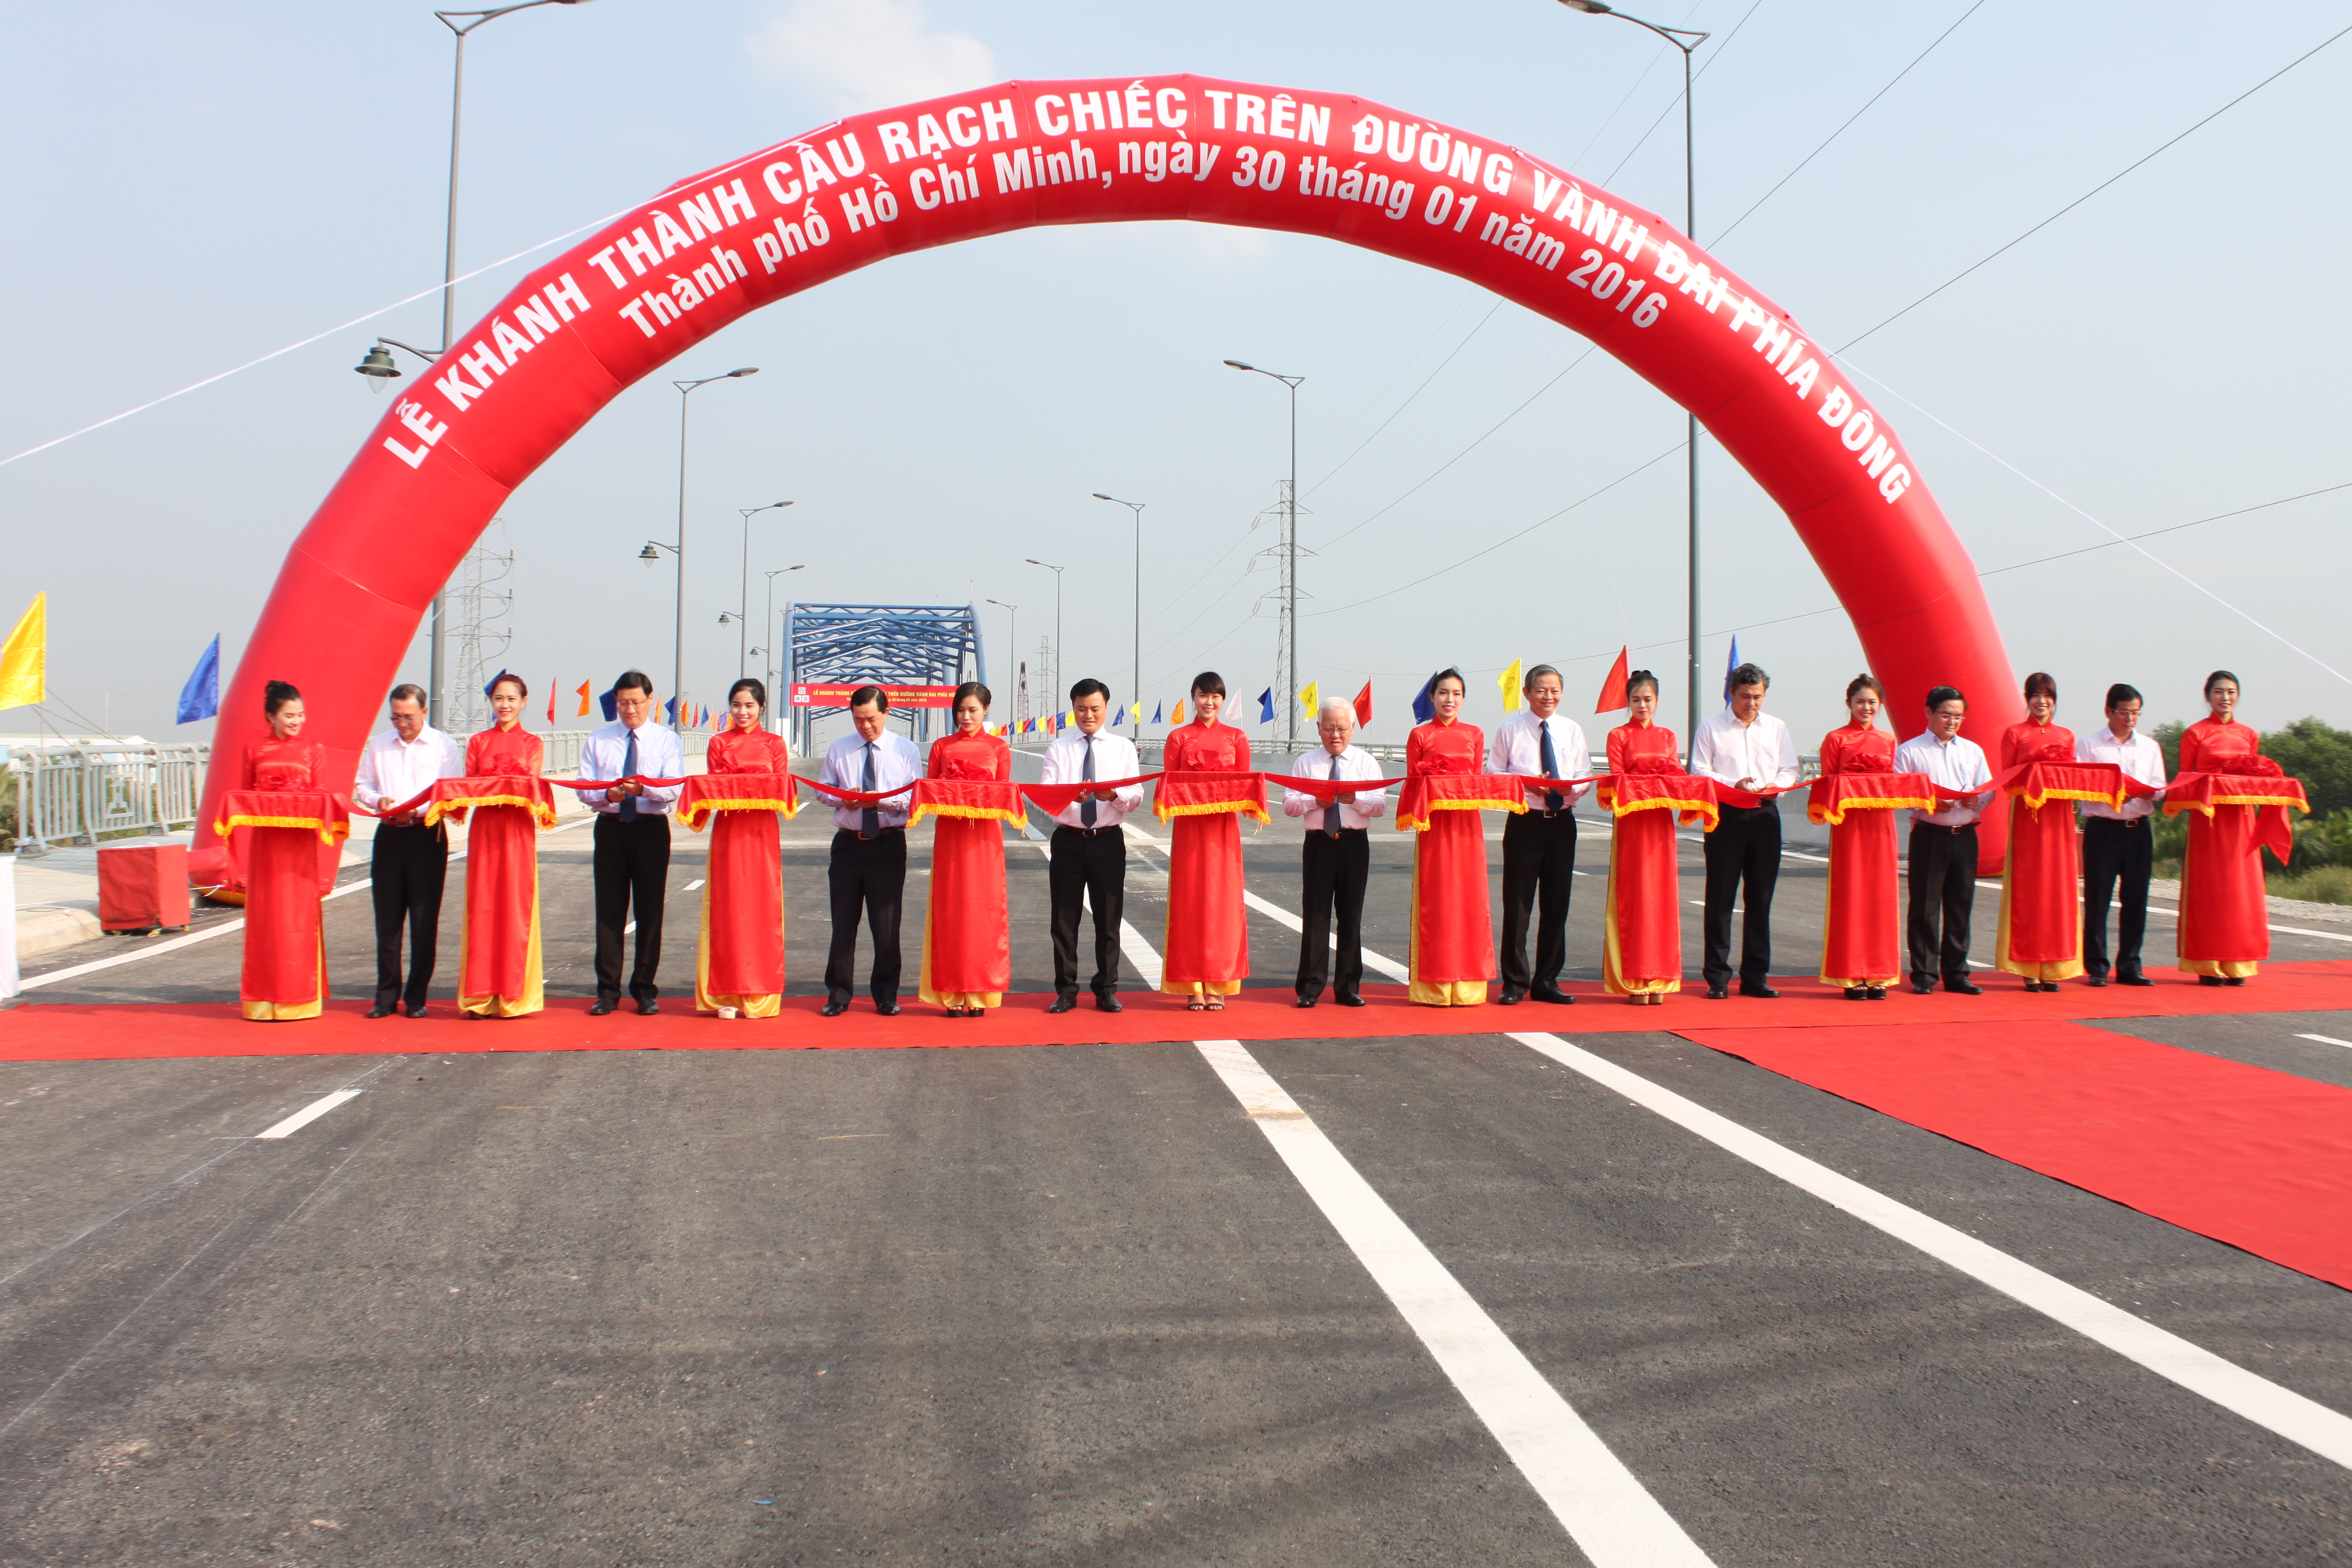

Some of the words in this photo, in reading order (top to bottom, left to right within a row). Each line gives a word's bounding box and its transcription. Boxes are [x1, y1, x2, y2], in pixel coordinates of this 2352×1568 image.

[383, 397, 448, 469] LỄ
[434, 273, 591, 412] KHÁNH
[588, 178, 757, 289] THÀNH
[763, 133, 865, 204] CẦU
[877, 98, 1018, 163] RẠCH
[1035, 80, 1187, 136] CHIẾC
[1205, 90, 1331, 147] TRÊN
[1352, 114, 1516, 196] ĐƯỜNG
[1533, 169, 1649, 262] VÀNH
[1654, 241, 1730, 314] ĐAI
[1729, 296, 1820, 399] PHÍA
[1817, 386, 1911, 504] ĐÔNG
[618, 245, 748, 338] Thành
[752, 197, 830, 274] phố
[839, 173, 898, 233] Hồ
[909, 153, 980, 210] Chí
[992, 139, 1112, 194] Minh,
[1119, 129, 1221, 182] ngày
[1232, 146, 1286, 191] 30
[1299, 156, 1415, 220] tháng
[1424, 186, 1478, 233] 01
[1479, 213, 1565, 271] năm
[1566, 248, 1667, 328] 2016
